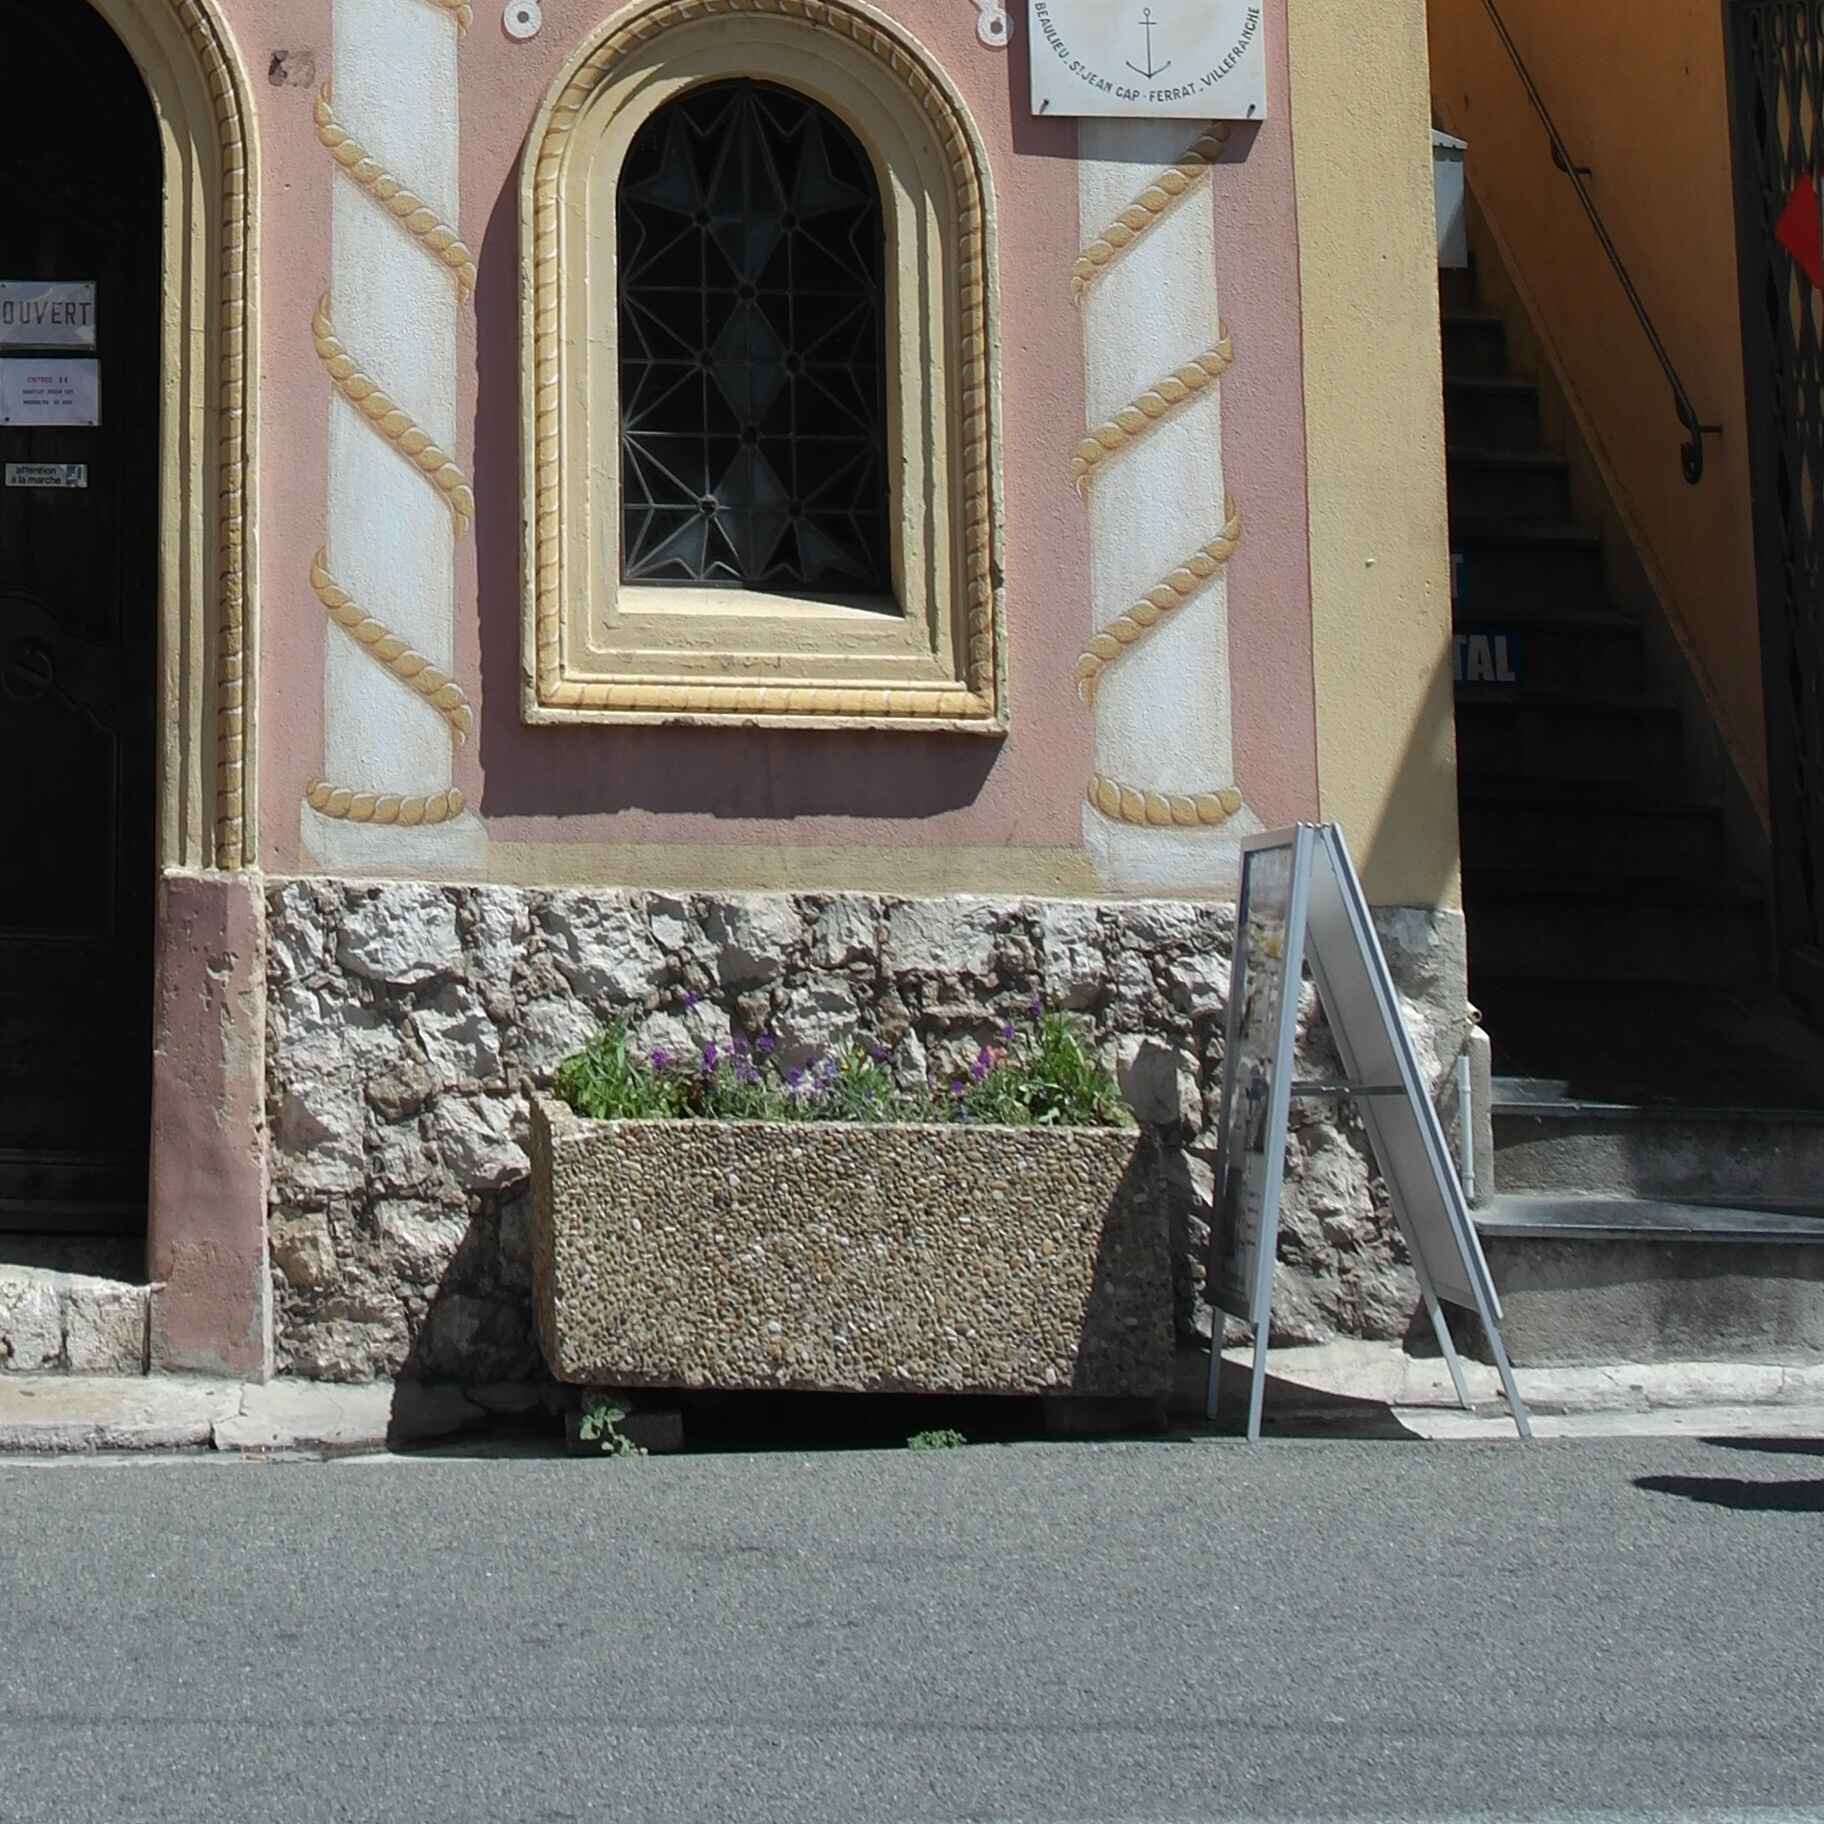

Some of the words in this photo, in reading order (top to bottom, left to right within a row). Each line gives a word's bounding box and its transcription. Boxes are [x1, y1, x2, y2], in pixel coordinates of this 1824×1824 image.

[1034, 1, 1070, 59] BEAULIEU
[1081, 71, 1113, 94] JEAN
[1200, 6, 1261, 88] VILLEFRANCHE
[2, 300, 92, 325] OUVERT
